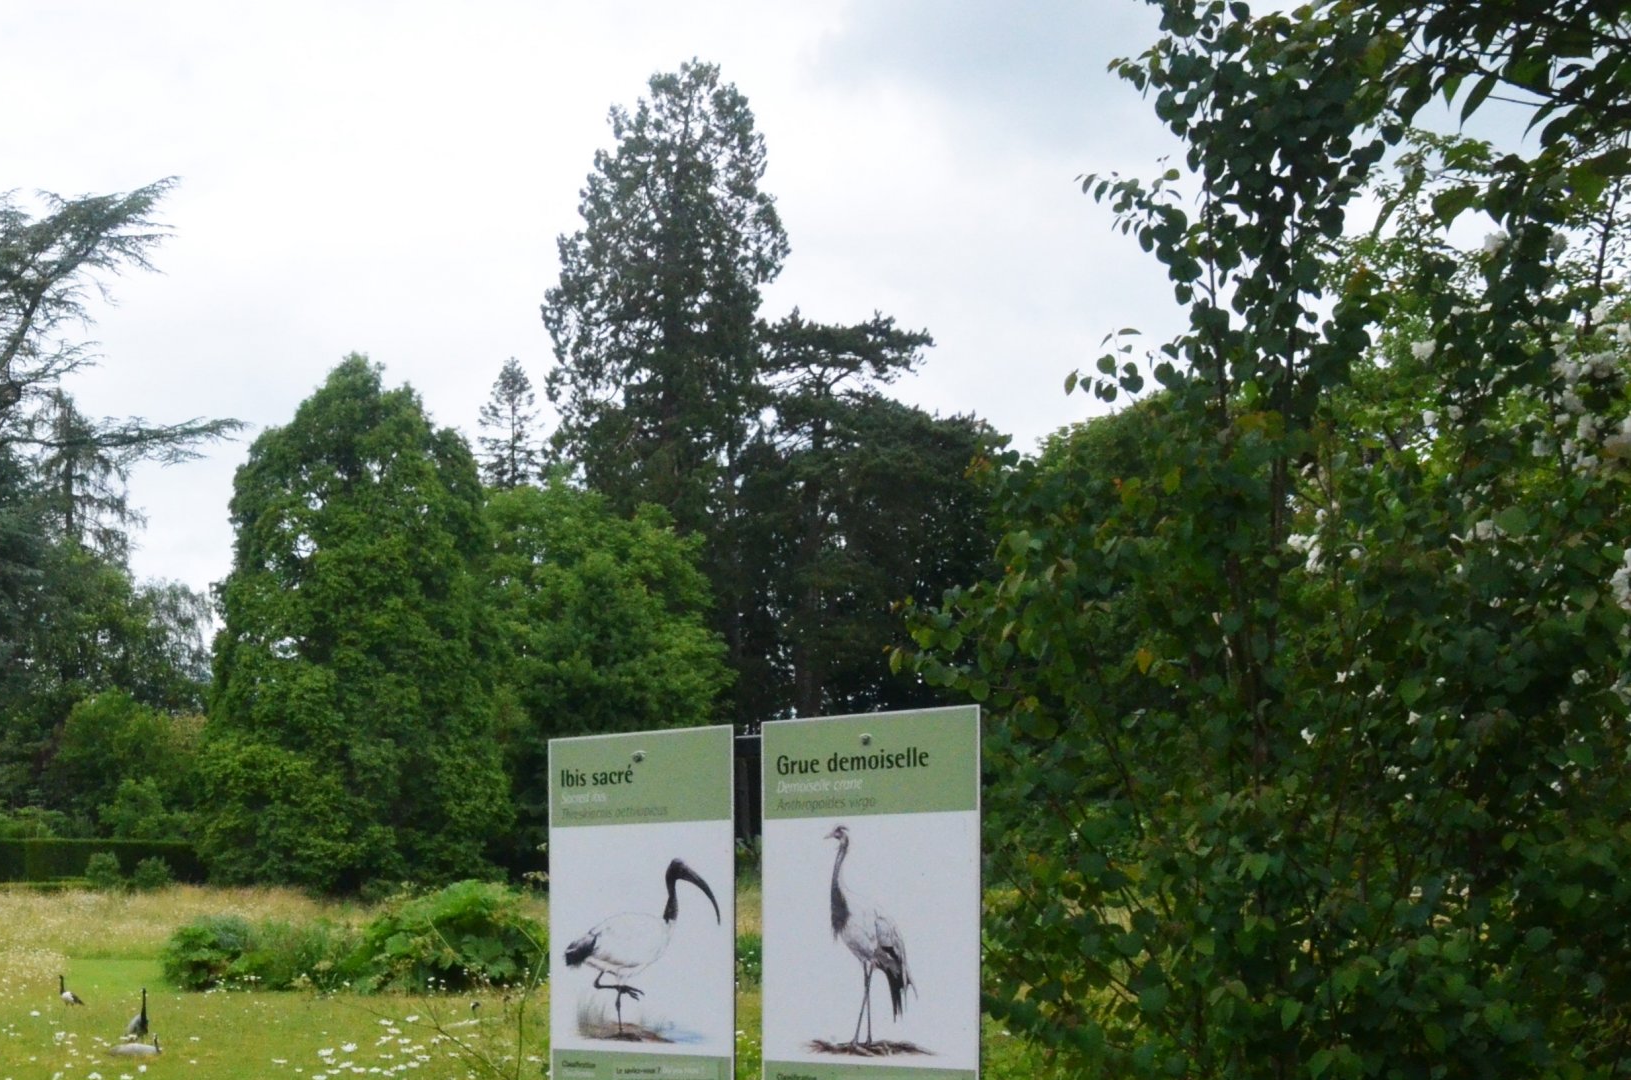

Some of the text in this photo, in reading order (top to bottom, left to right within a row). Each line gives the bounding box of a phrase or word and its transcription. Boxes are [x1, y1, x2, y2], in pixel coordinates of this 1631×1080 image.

[776, 747, 930, 776] Grue demoiselle
[560, 763, 634, 788] Ibis sacré
[776, 778, 864, 794] Demoiselle crane
